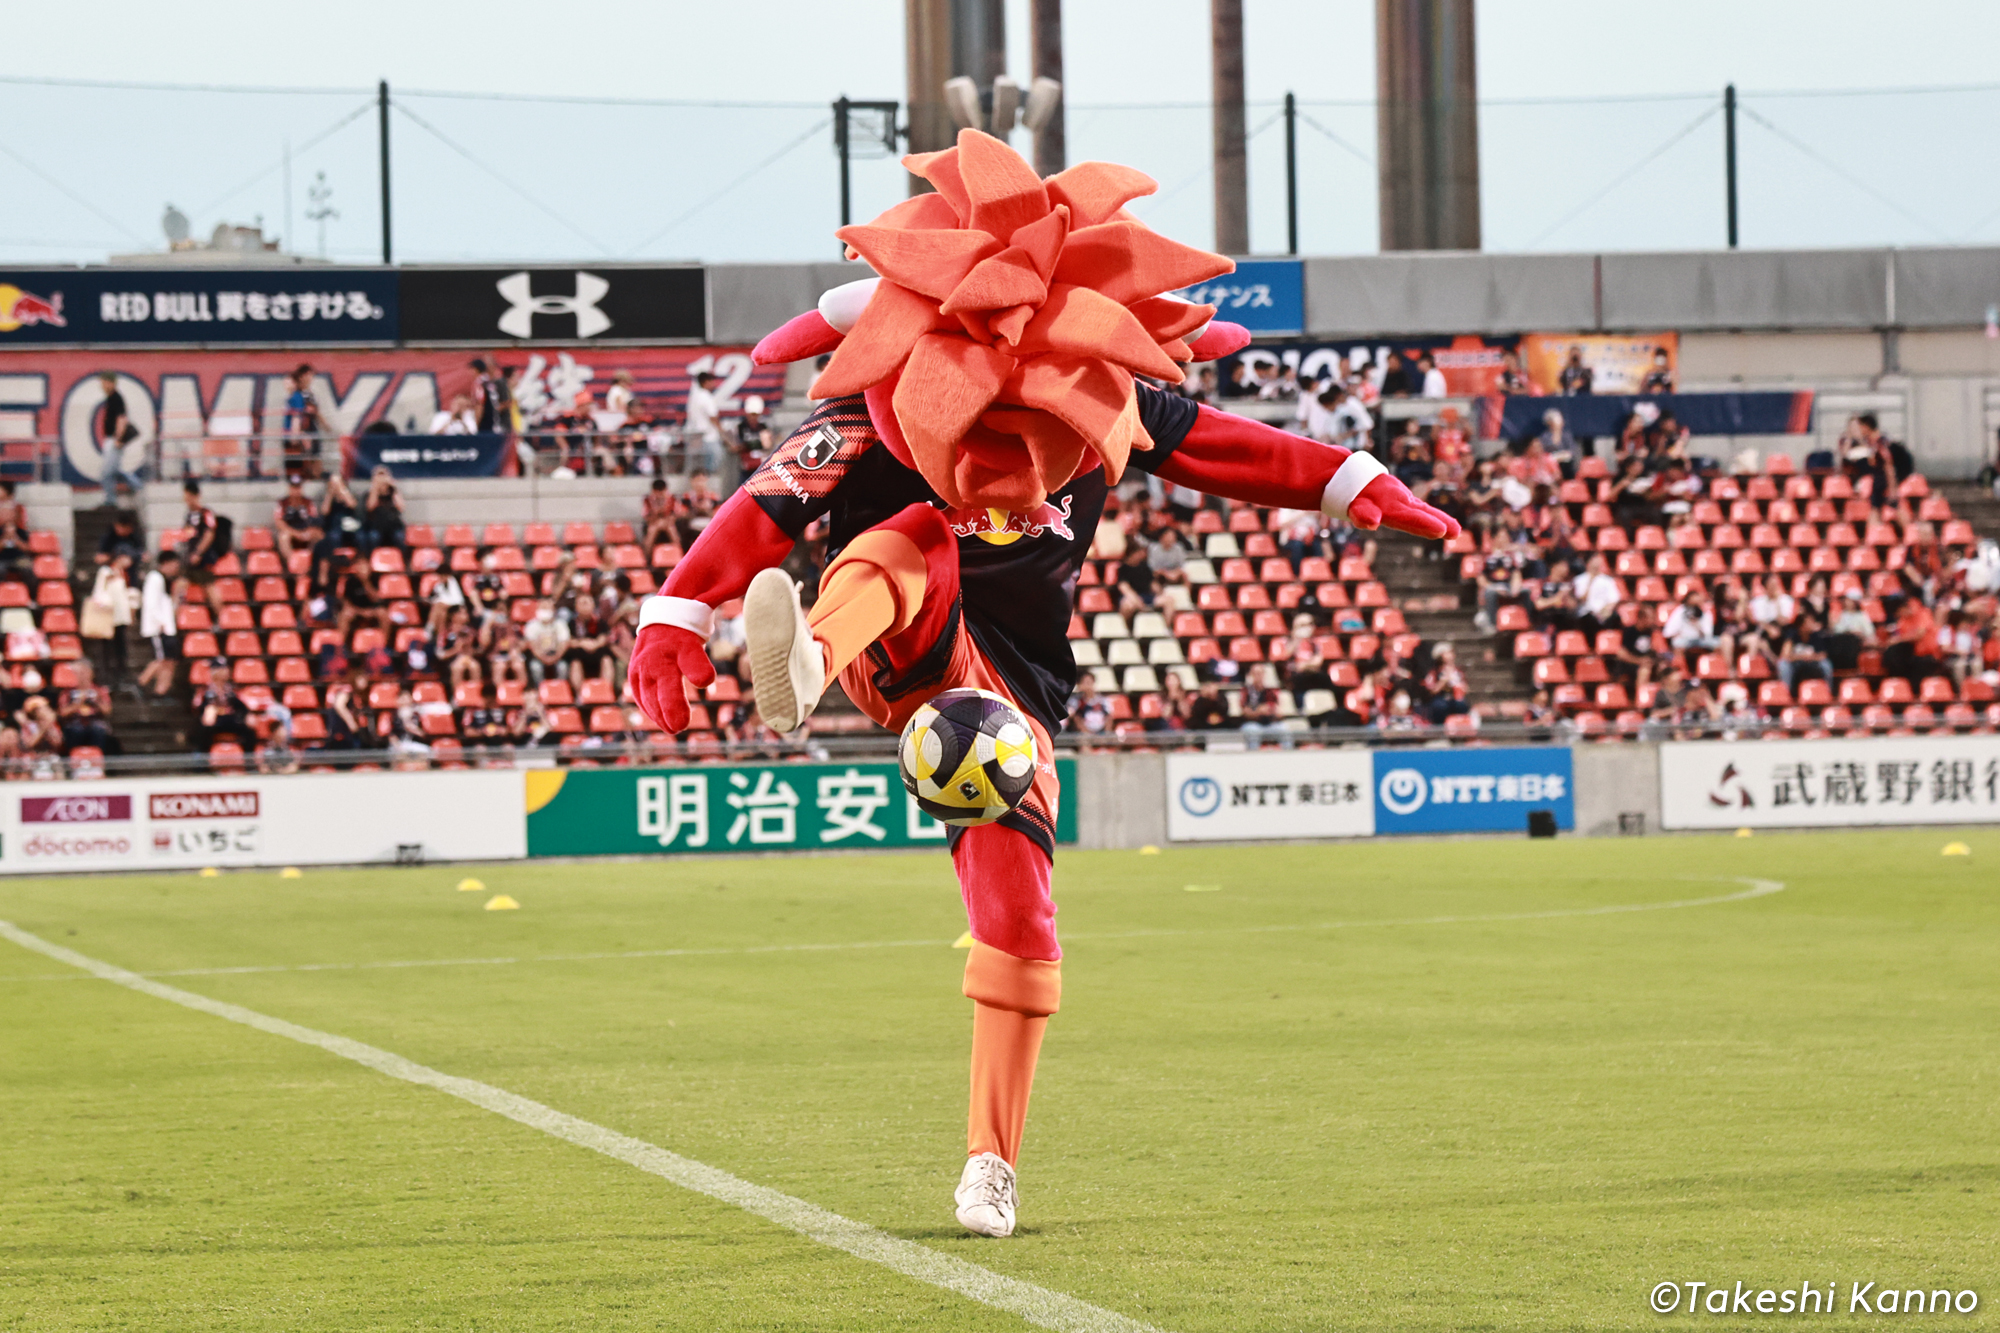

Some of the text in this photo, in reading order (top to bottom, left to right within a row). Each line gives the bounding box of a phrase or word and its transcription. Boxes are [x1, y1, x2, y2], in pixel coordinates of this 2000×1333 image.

[100, 292, 150, 322] RED
[153, 292, 212, 322] BULL
[771, 461, 810, 505] SAITAMA
[152, 793, 256, 818] KONAMI
[24, 832, 131, 857] docomo
[178, 825, 259, 852] いちご
